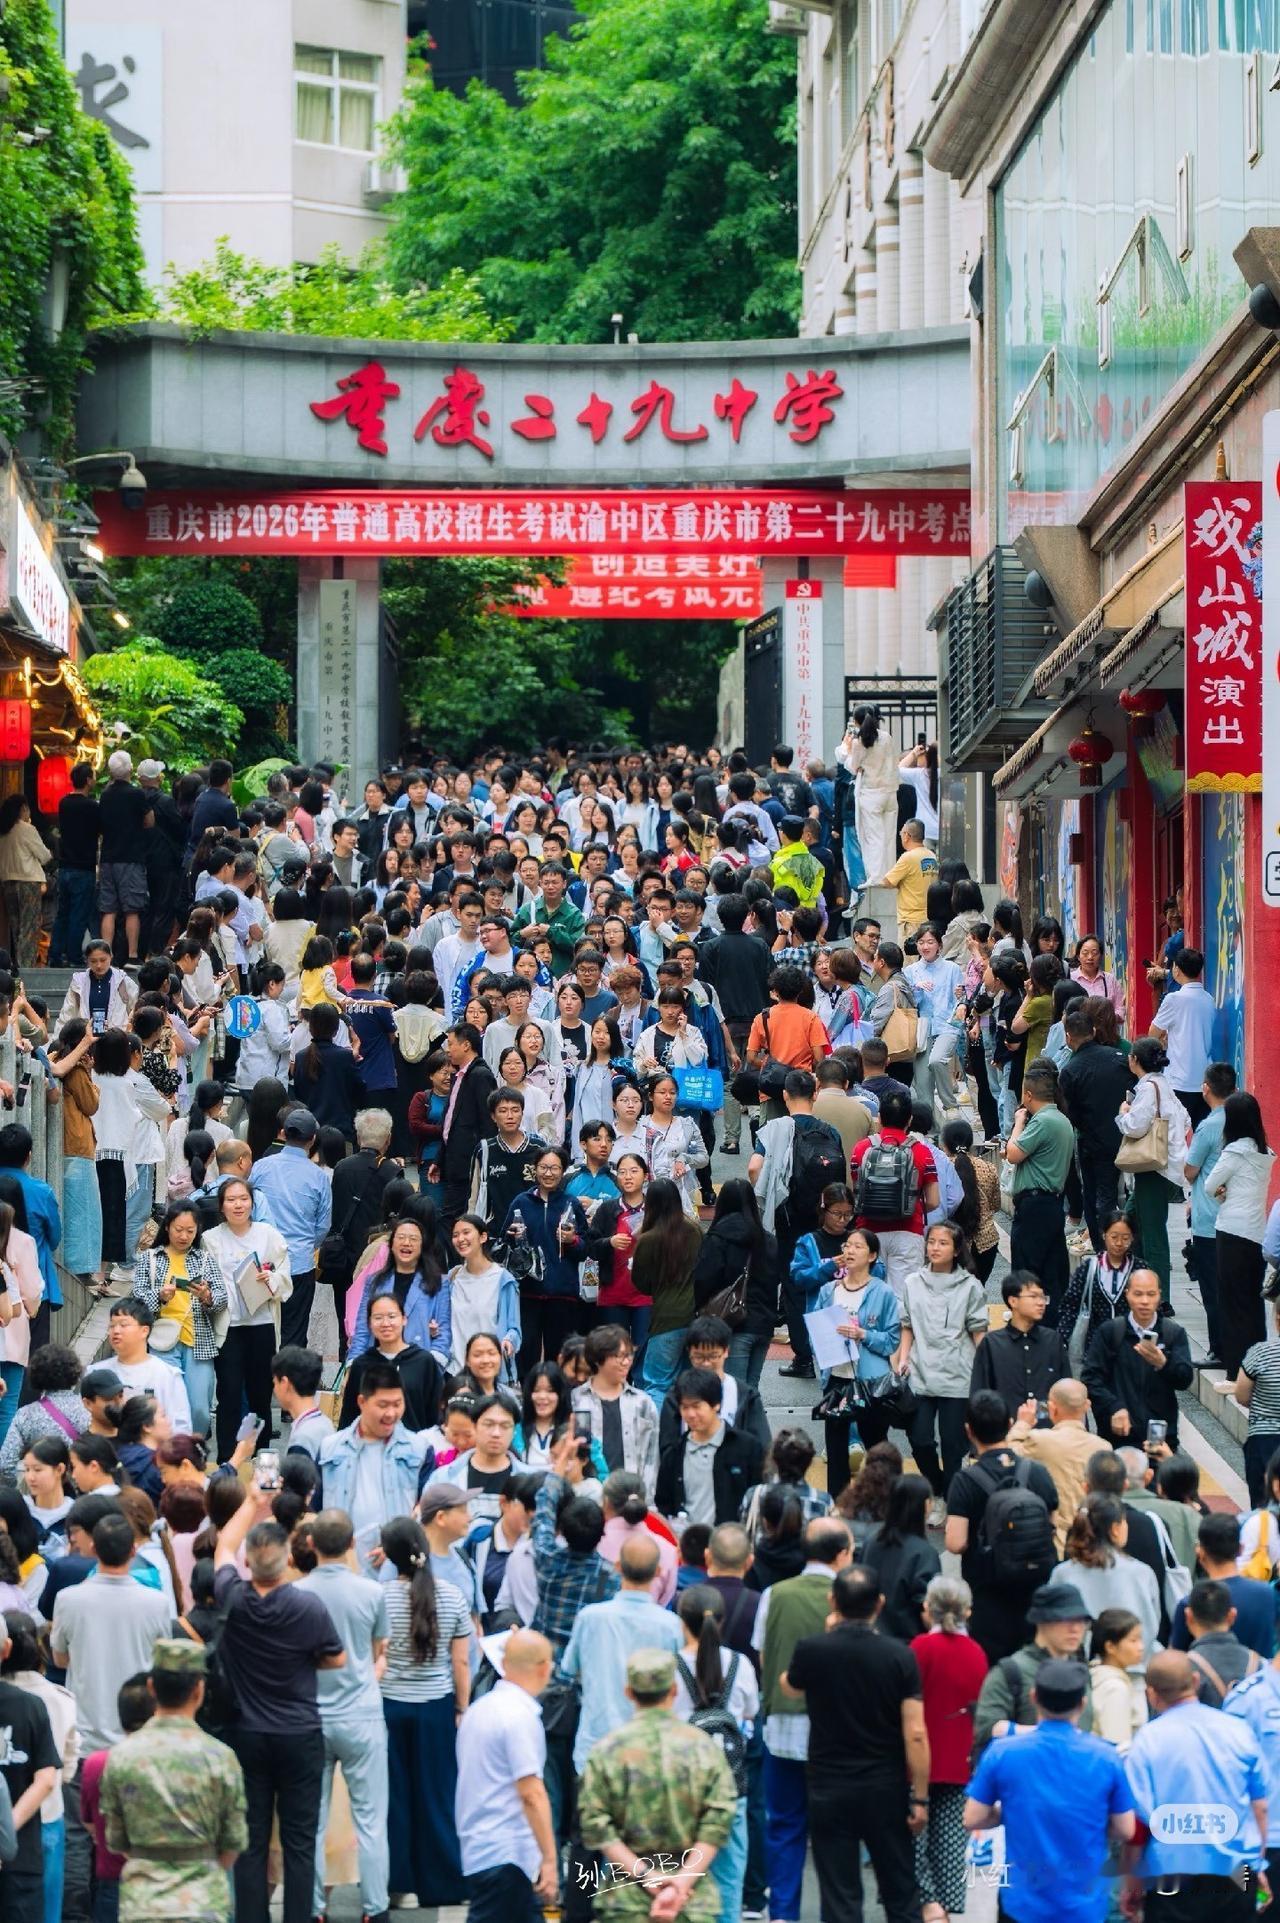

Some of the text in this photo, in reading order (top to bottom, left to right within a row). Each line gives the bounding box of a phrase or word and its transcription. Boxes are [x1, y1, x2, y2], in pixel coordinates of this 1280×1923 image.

[145, 501, 971, 543] 重庆市2026年普通高校招生考试渝中区重庆市第二十九中考点
[1190, 497, 1254, 745] 戏山城演出
